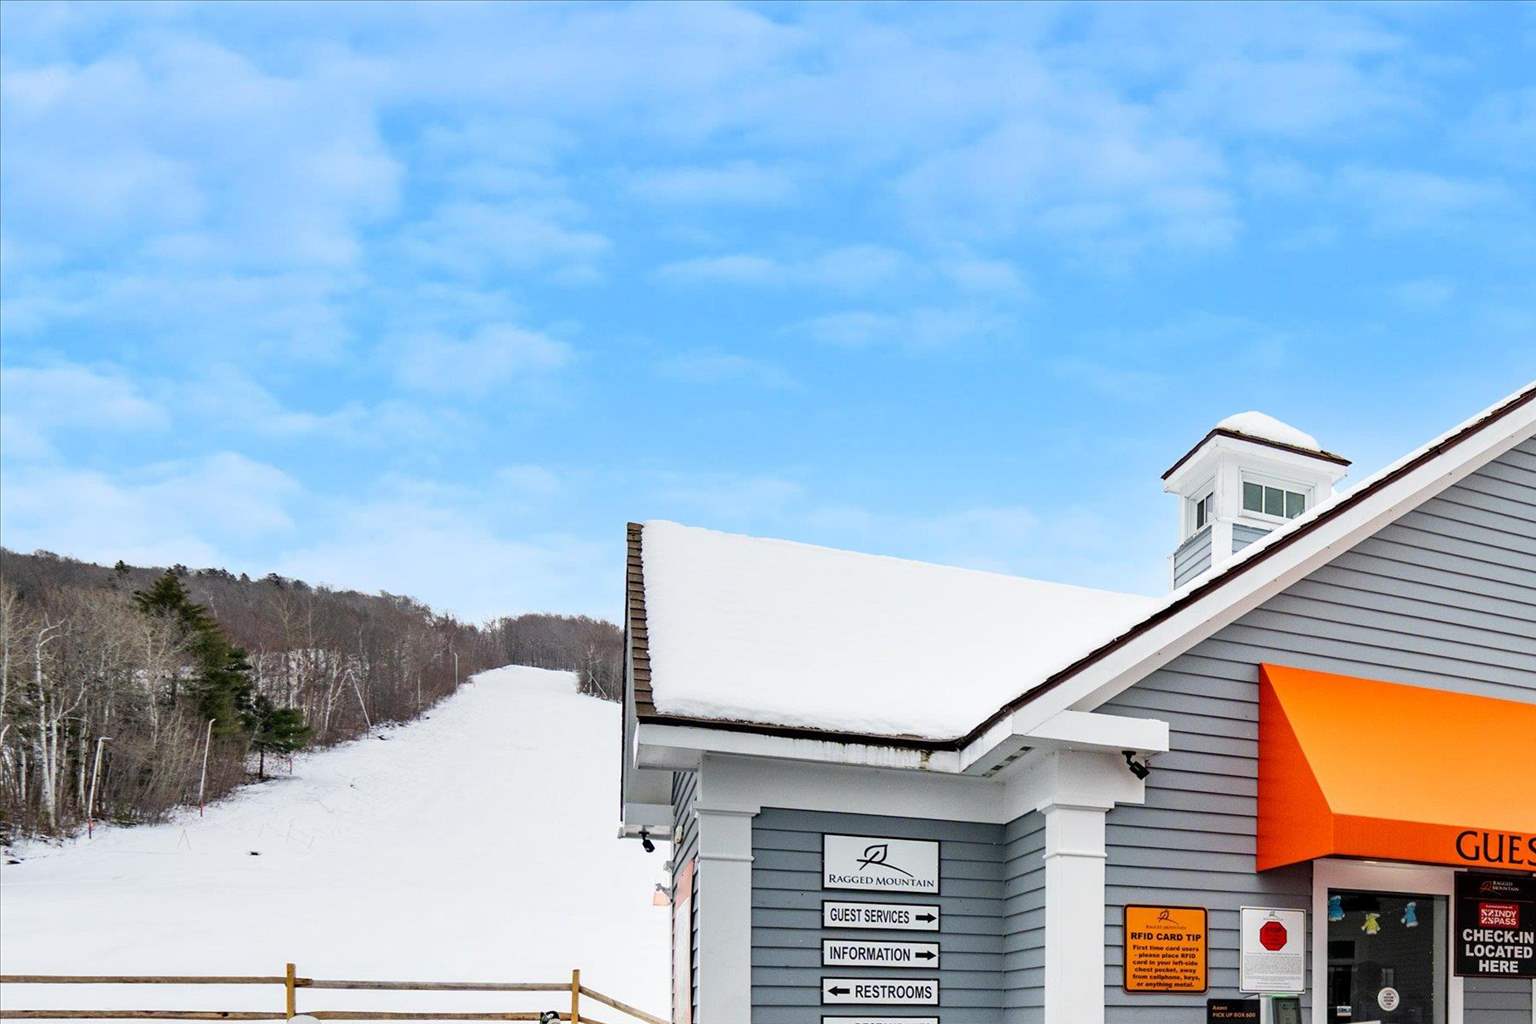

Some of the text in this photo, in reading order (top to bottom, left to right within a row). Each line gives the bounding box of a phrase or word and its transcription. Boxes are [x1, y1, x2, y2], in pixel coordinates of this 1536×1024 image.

[829, 874, 935, 888] RAGGED MOUNTAIN
[830, 908, 910, 924] GUEST SERVICES
[1131, 932, 1153, 940] RFID
[1156, 933, 1183, 941] CARD
[1462, 928, 1535, 944] CHECK-IN
[829, 946, 911, 961] INFORMATION
[1465, 944, 1533, 959] LOCATED
[1479, 960, 1519, 973] HERE
[855, 985, 932, 999] RESTROOMS
